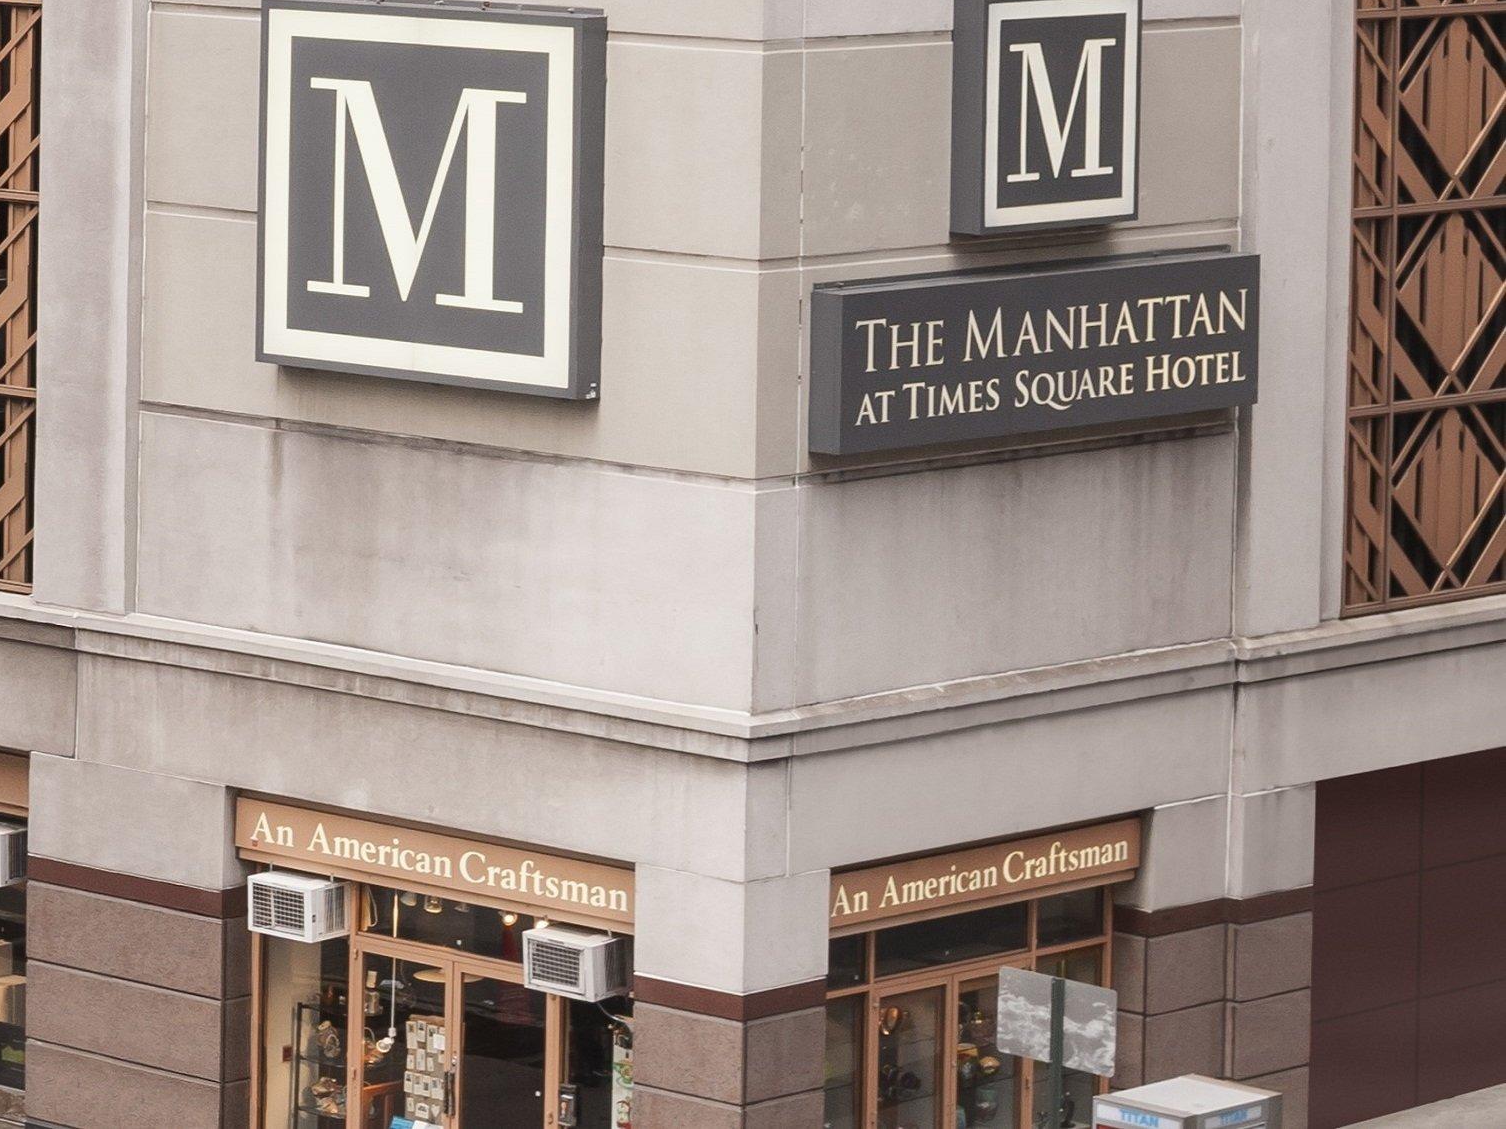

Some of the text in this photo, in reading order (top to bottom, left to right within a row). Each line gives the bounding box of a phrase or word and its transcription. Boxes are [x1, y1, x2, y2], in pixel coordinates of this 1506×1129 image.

[1006, 38, 1116, 183] M
[307, 77, 527, 314] M
[855, 288, 1249, 373] THE MANHATTAN
[854, 350, 1247, 426] AT TIMES SQUARE HOTEL
[250, 812, 629, 913] An American Craftsman
[830, 841, 1128, 918] An American Craftsman
